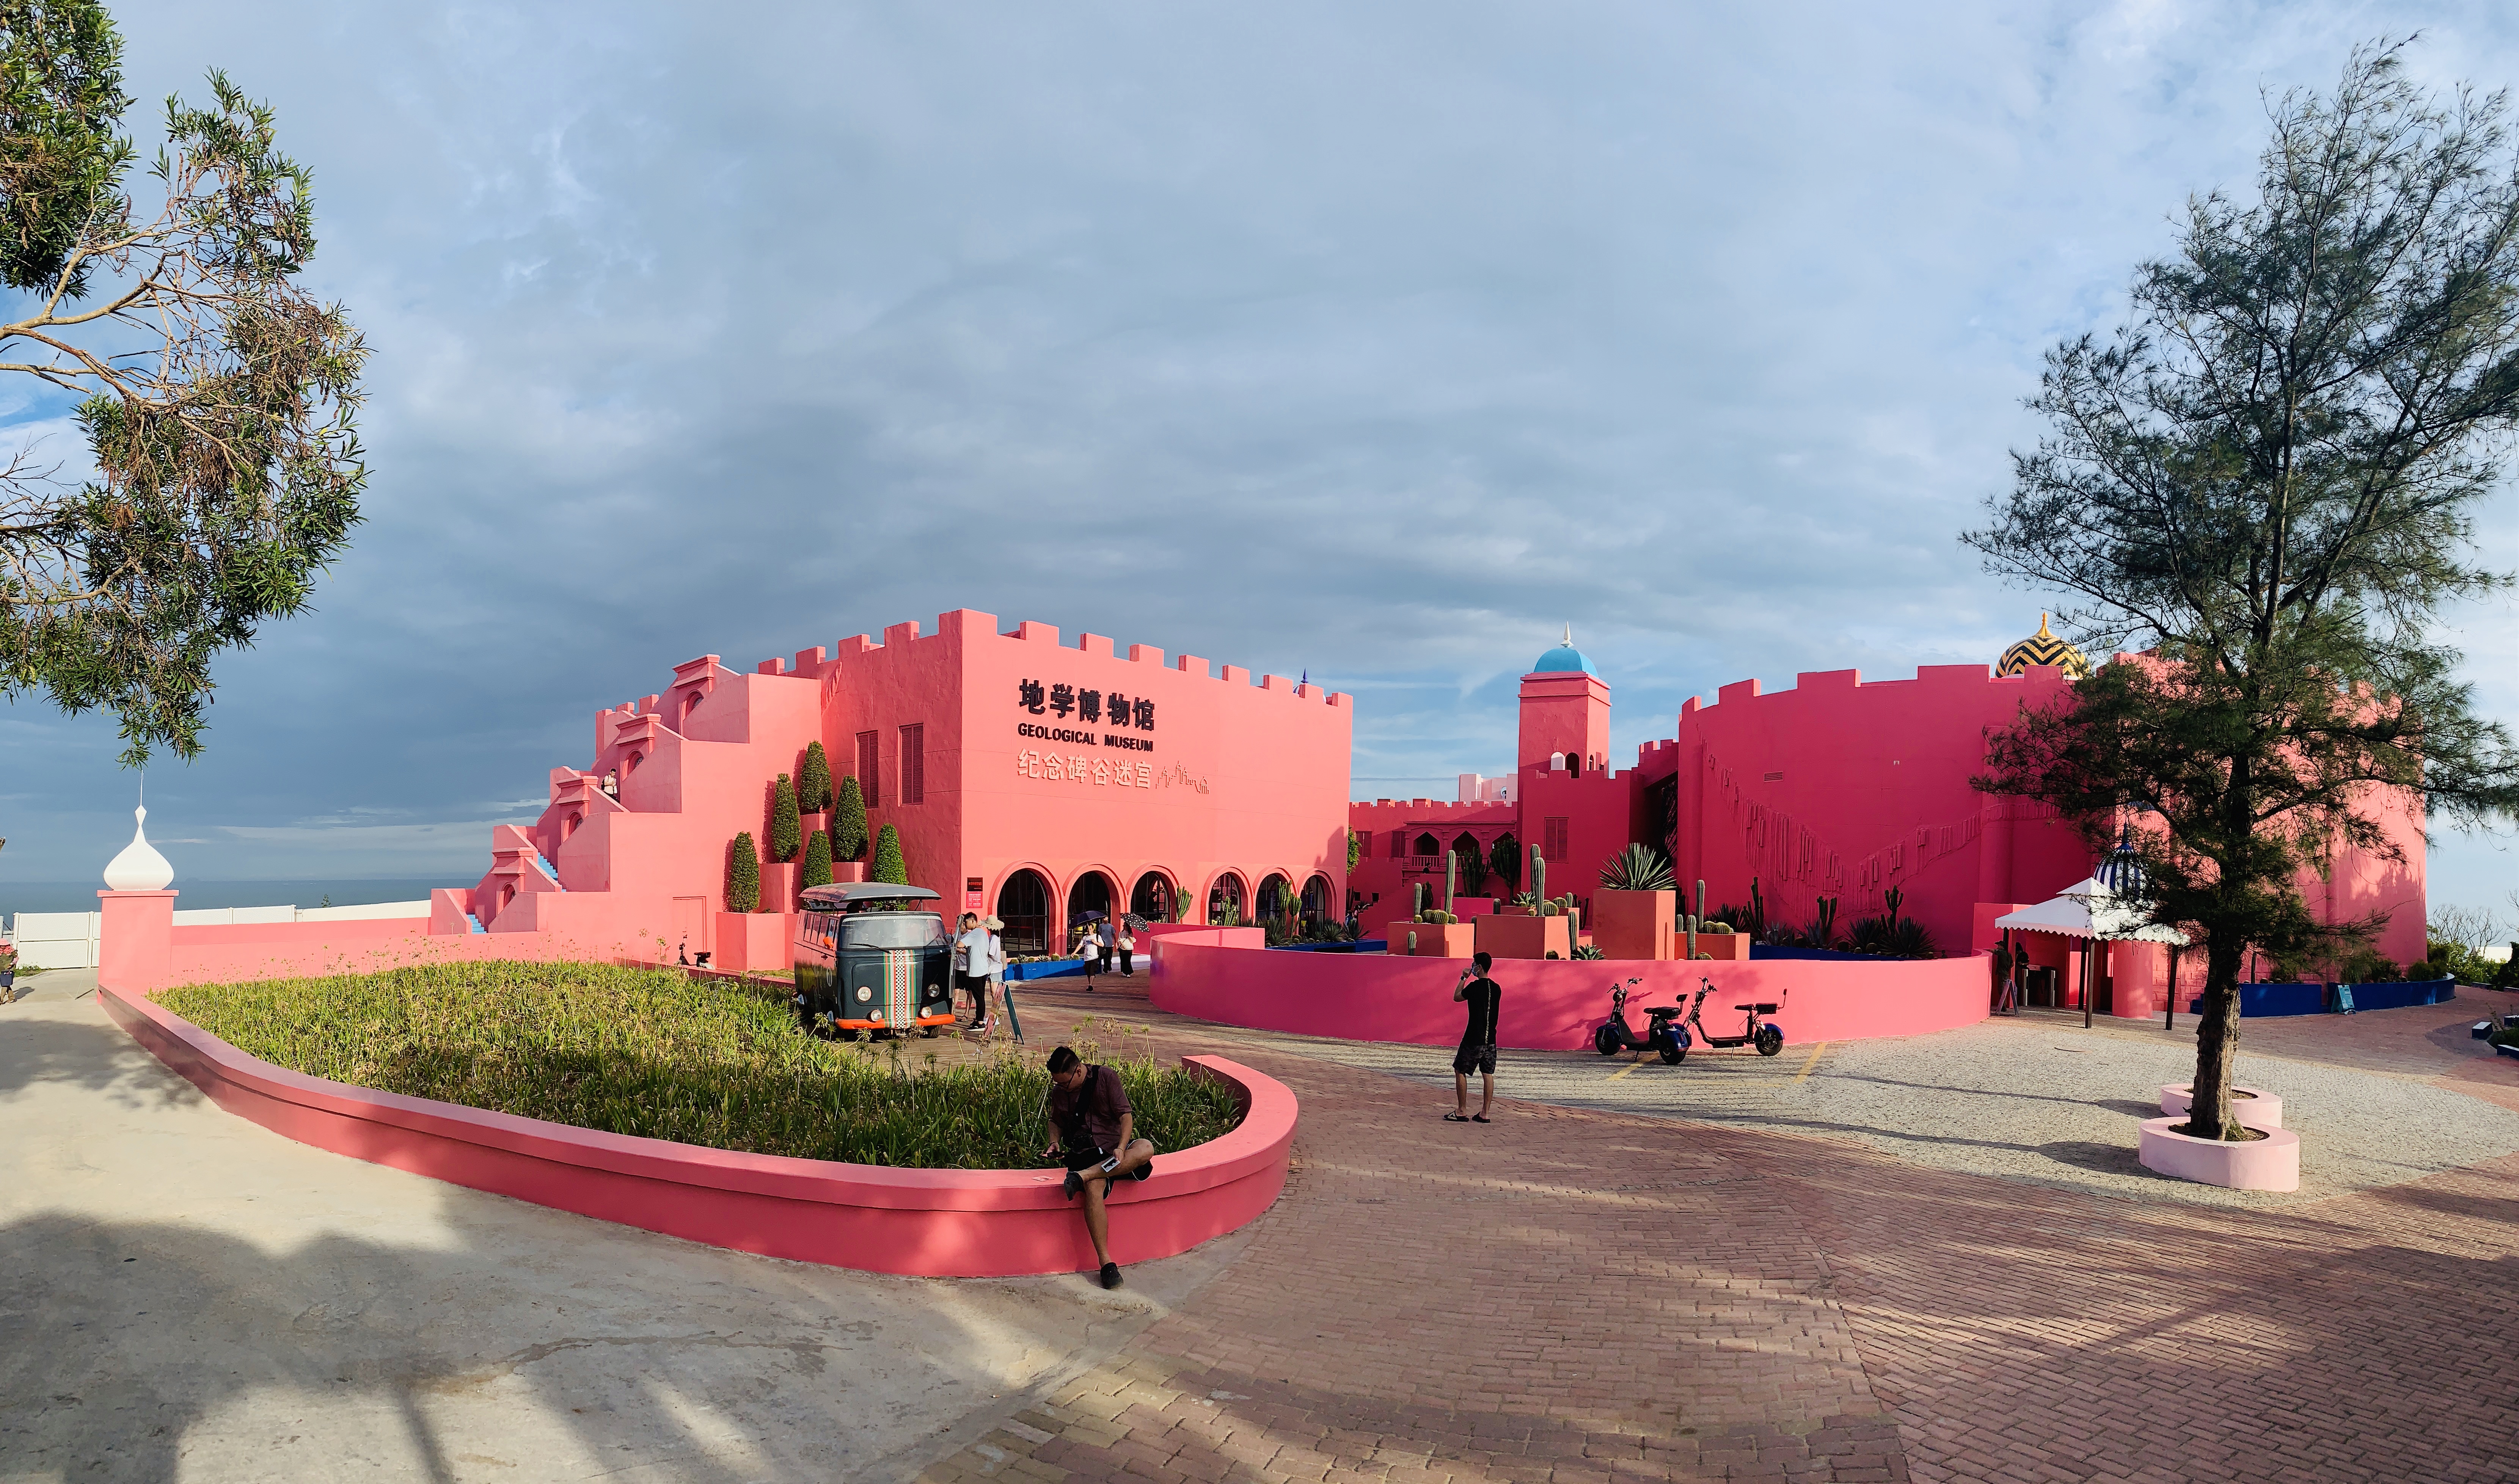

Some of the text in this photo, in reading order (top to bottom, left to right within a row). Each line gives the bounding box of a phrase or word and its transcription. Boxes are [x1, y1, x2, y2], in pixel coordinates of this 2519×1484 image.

[1019, 679, 1154, 731] 地学博物馆
[1018, 723, 1153, 752] GEOLOGICAL MUSEUM
[1018, 748, 1152, 789] 纪念碑谷迷宫
